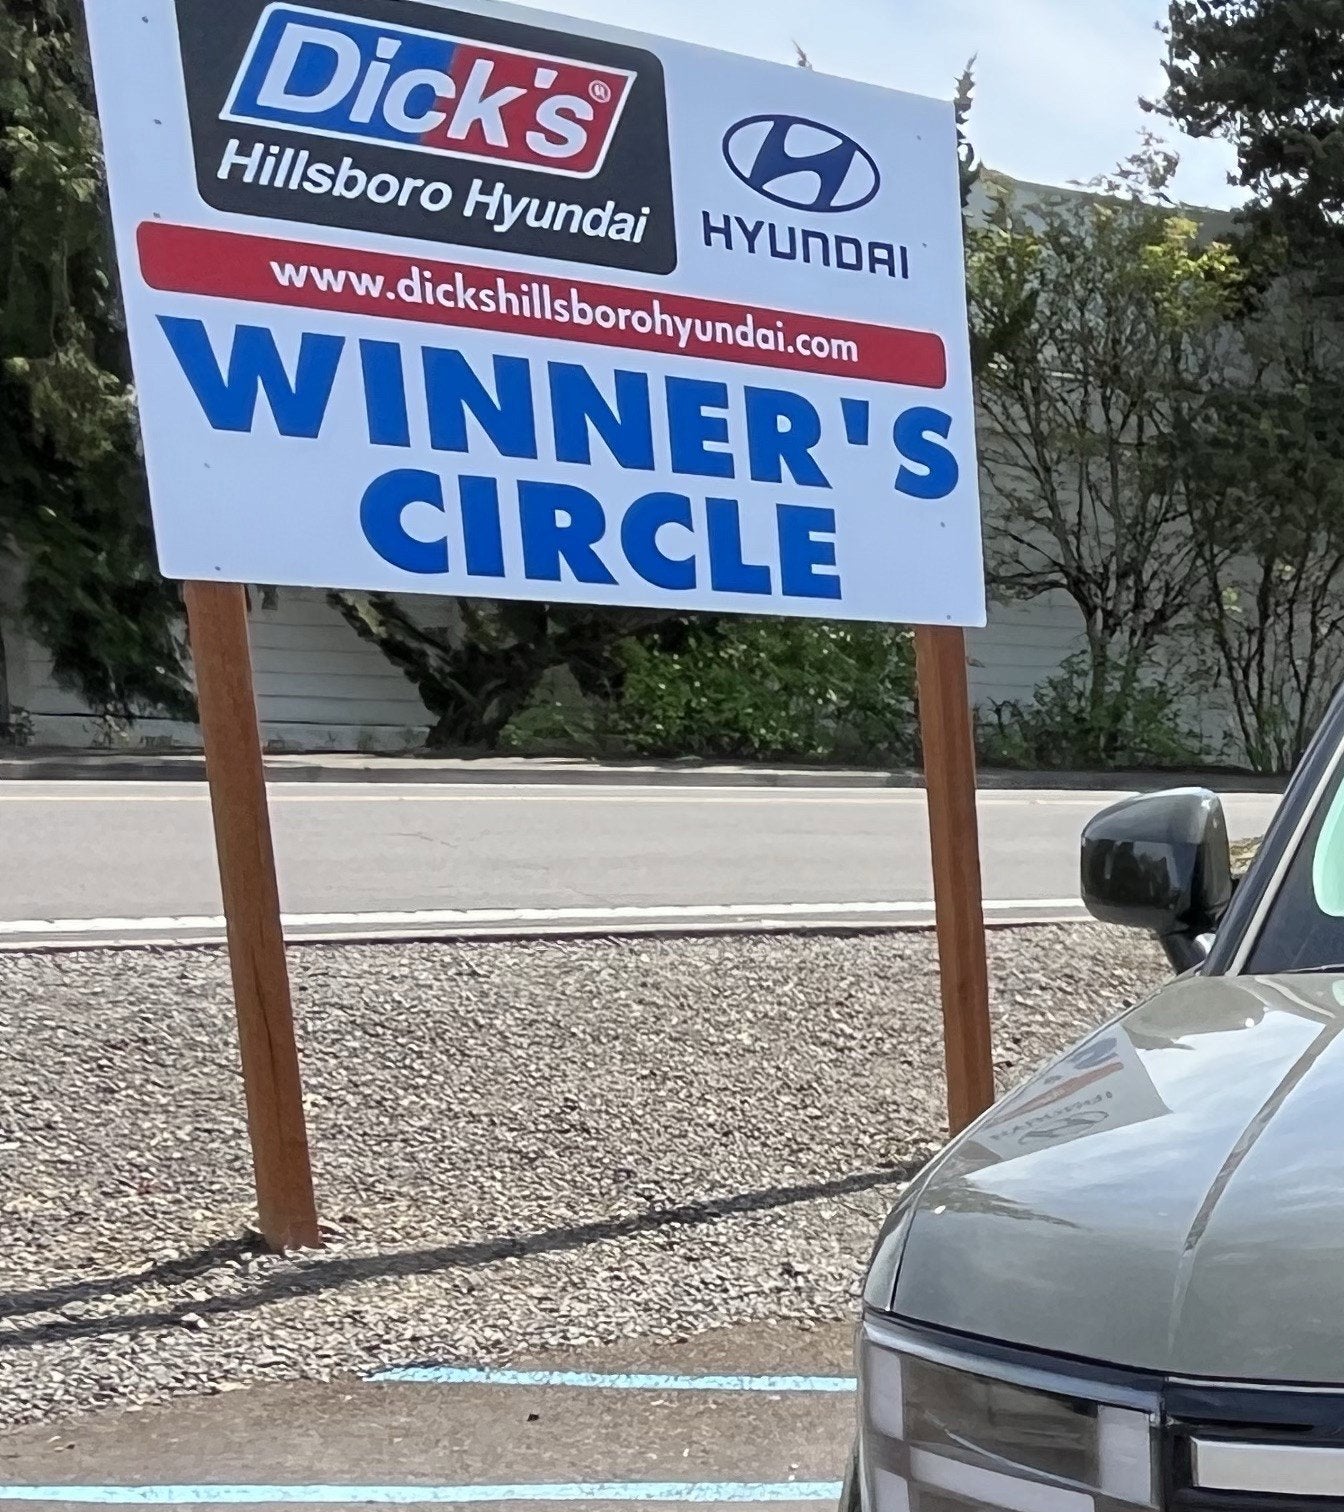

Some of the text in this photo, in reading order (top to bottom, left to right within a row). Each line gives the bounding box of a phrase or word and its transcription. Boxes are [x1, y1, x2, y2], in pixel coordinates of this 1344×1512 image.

[255, 21, 595, 160] Dick's
[217, 139, 650, 245] Hillsboro Hyundai
[702, 210, 910, 280] HYUNDAI
[269, 257, 859, 363] www.dickshillsborohyundai.com
[155, 314, 960, 500] WINNER'S
[360, 468, 842, 599] CIRCLE
